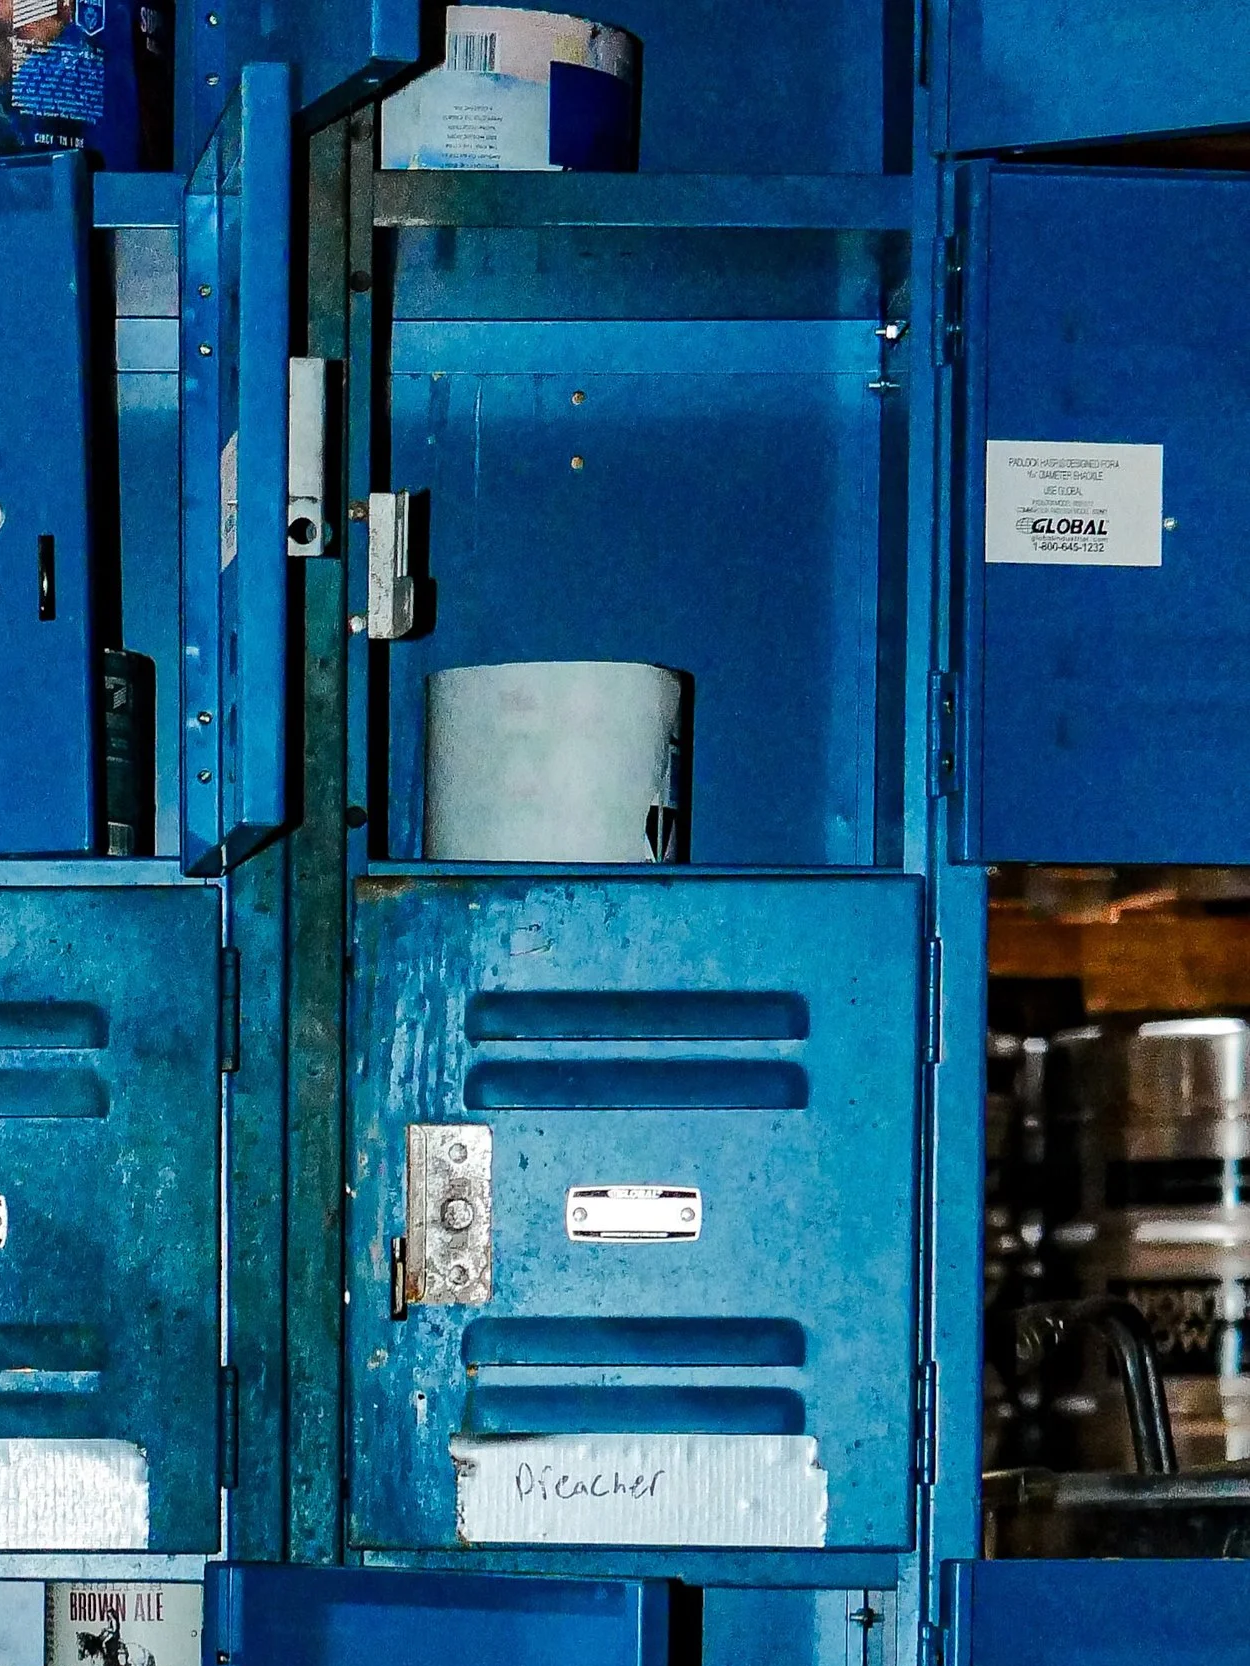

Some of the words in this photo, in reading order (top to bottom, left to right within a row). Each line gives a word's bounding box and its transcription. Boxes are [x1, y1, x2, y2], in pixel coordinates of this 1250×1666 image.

[1032, 518, 1108, 535] GLOBAL
[1034, 542, 1104, 552] 1-800-645-1232
[70, 1592, 126, 1622] BROWN
[134, 1592, 164, 1622] ALE
